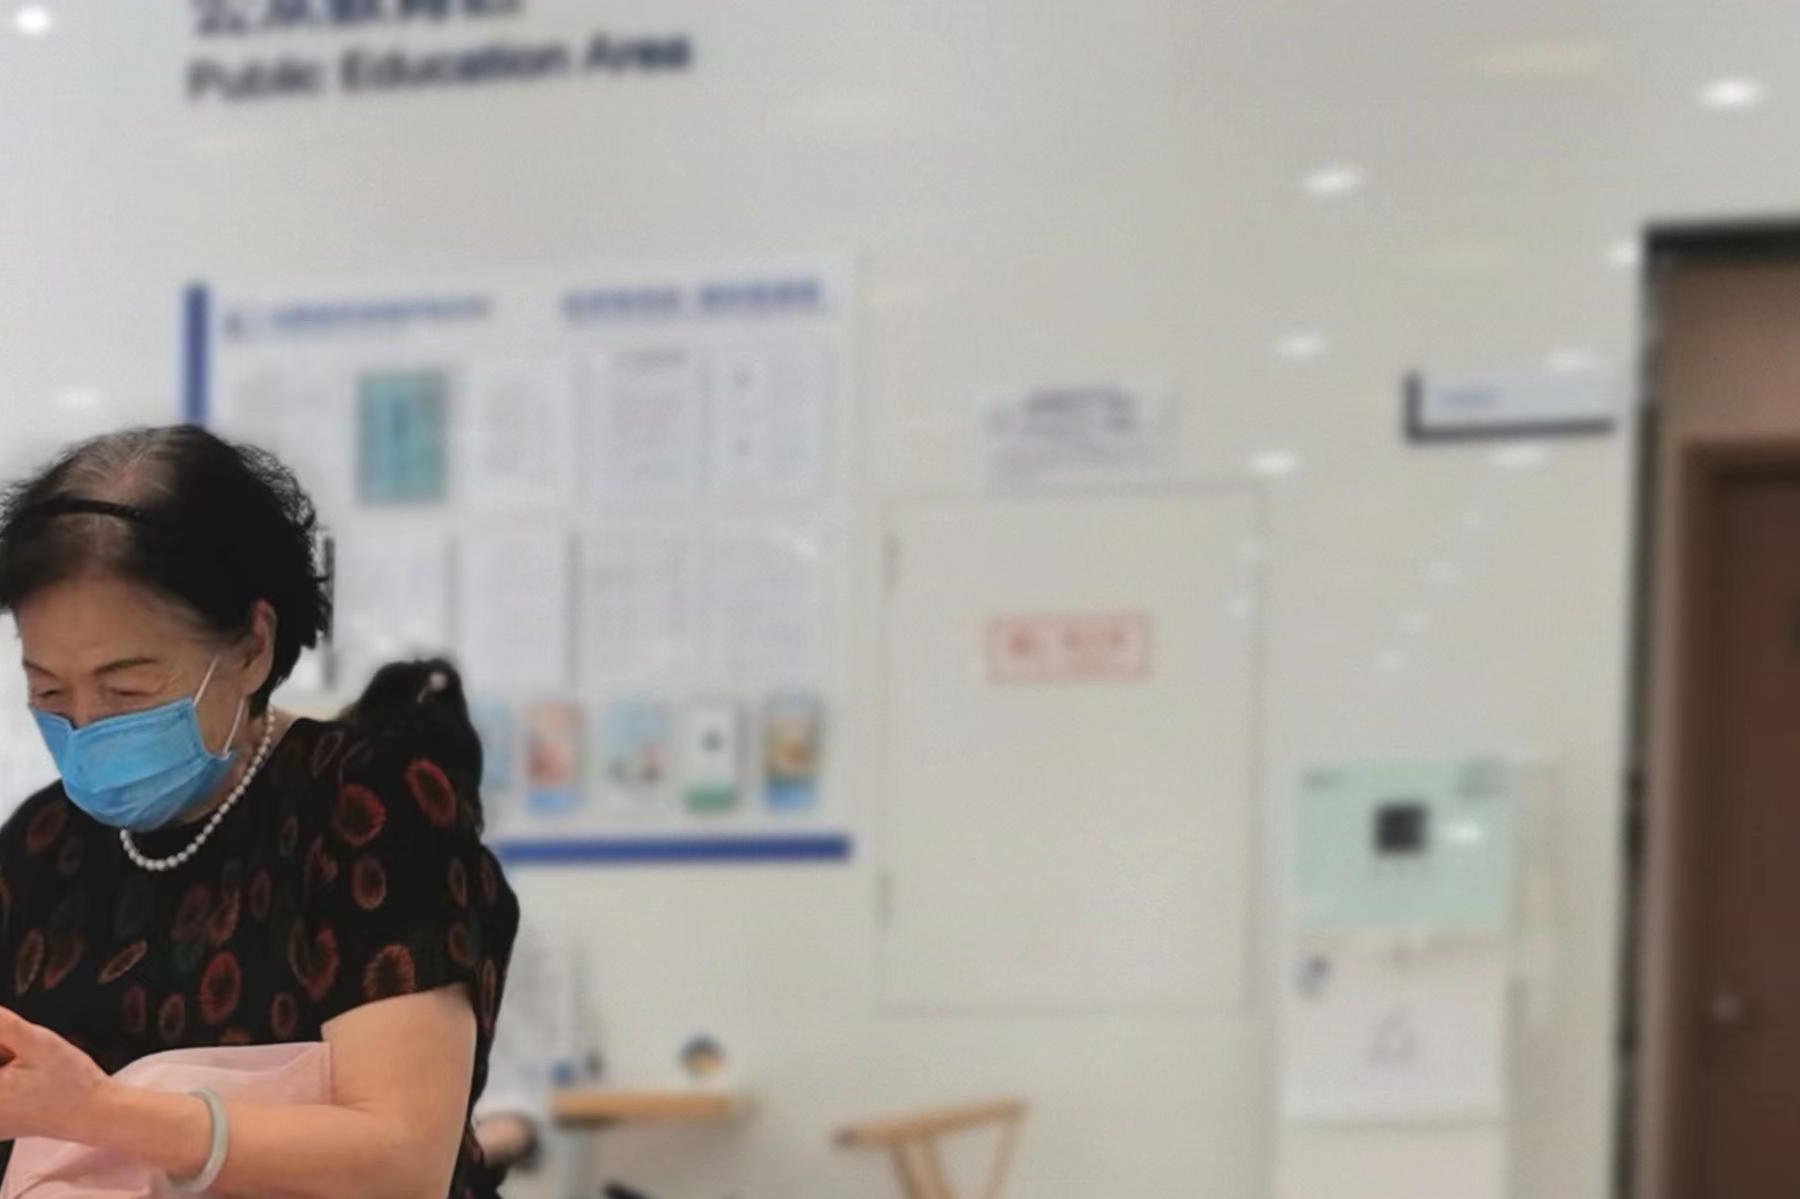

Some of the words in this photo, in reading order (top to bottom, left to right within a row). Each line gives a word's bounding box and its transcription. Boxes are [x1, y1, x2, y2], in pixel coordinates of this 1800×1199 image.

[188, 56, 323, 101] Public
[340, 42, 569, 92] Education
[584, 33, 692, 72] Area
